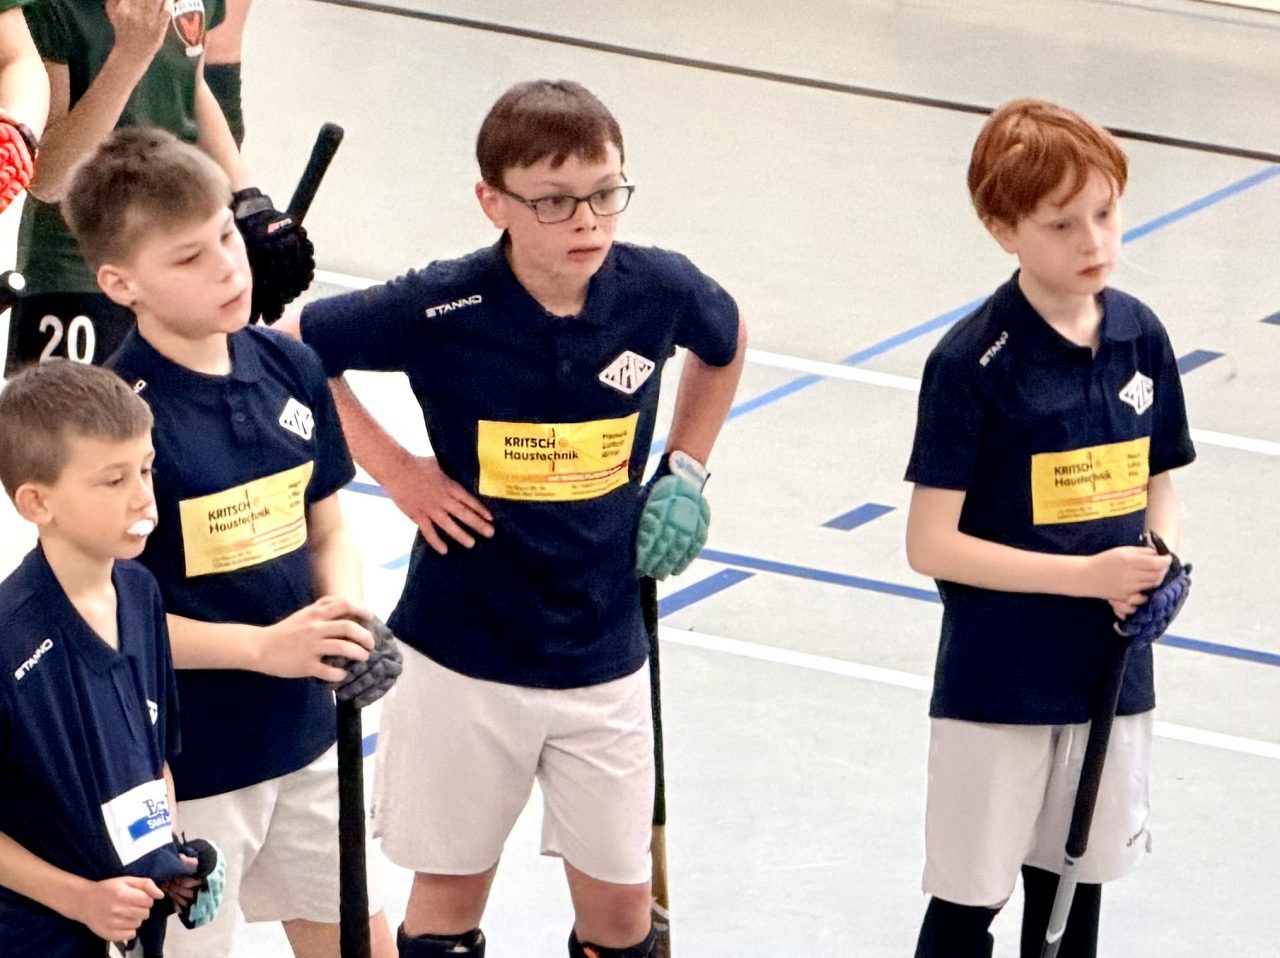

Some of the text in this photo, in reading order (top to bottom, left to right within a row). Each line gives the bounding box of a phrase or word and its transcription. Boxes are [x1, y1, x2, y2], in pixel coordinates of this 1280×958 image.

[39, 313, 96, 366] 20
[504, 436, 556, 449] KRITSCH
[504, 449, 579, 461] Haustechnik
[1054, 462, 1093, 476] KRITSCH
[208, 500, 251, 523] KRITSCH
